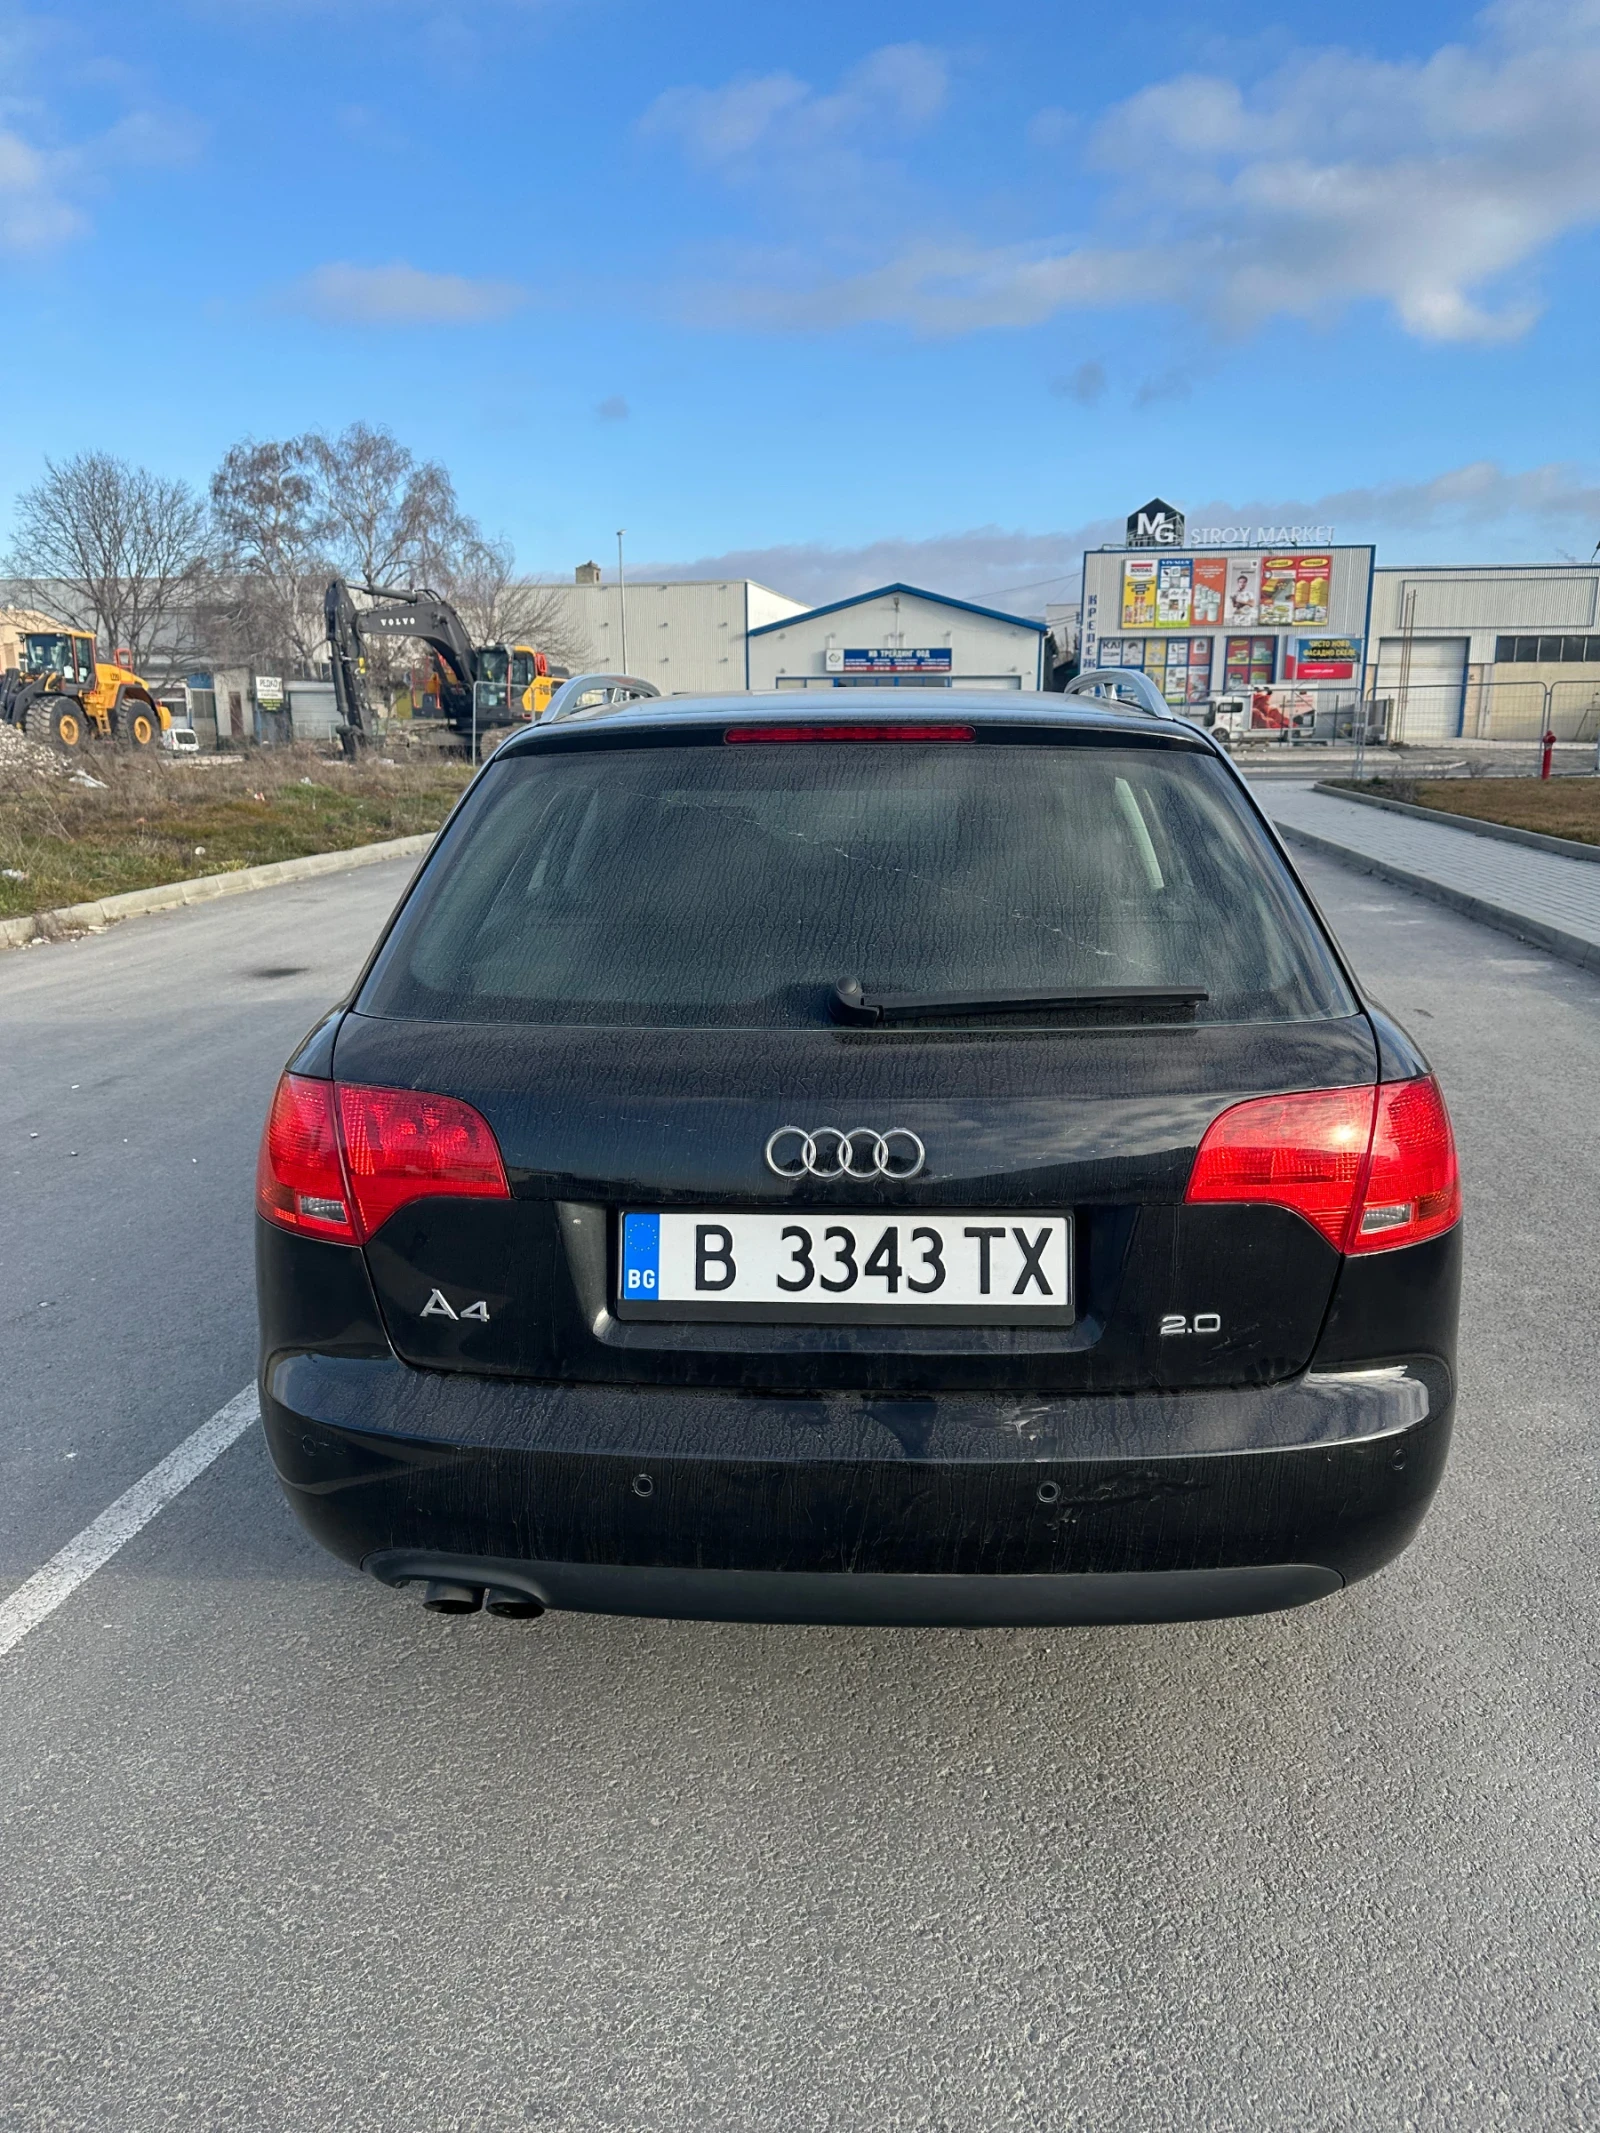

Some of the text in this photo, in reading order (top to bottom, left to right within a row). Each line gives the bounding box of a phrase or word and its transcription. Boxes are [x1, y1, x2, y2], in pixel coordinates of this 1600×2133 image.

[1137, 512, 1174, 543] MG
[1190, 525, 1336, 545] STROY MARKET
[380, 617, 416, 626] VOLVO
[695, 1224, 1054, 1296] B 3343 TX
[627, 1269, 656, 1289] BG
[420, 1288, 490, 1323] A4
[1160, 1314, 1221, 1335] 2.0
